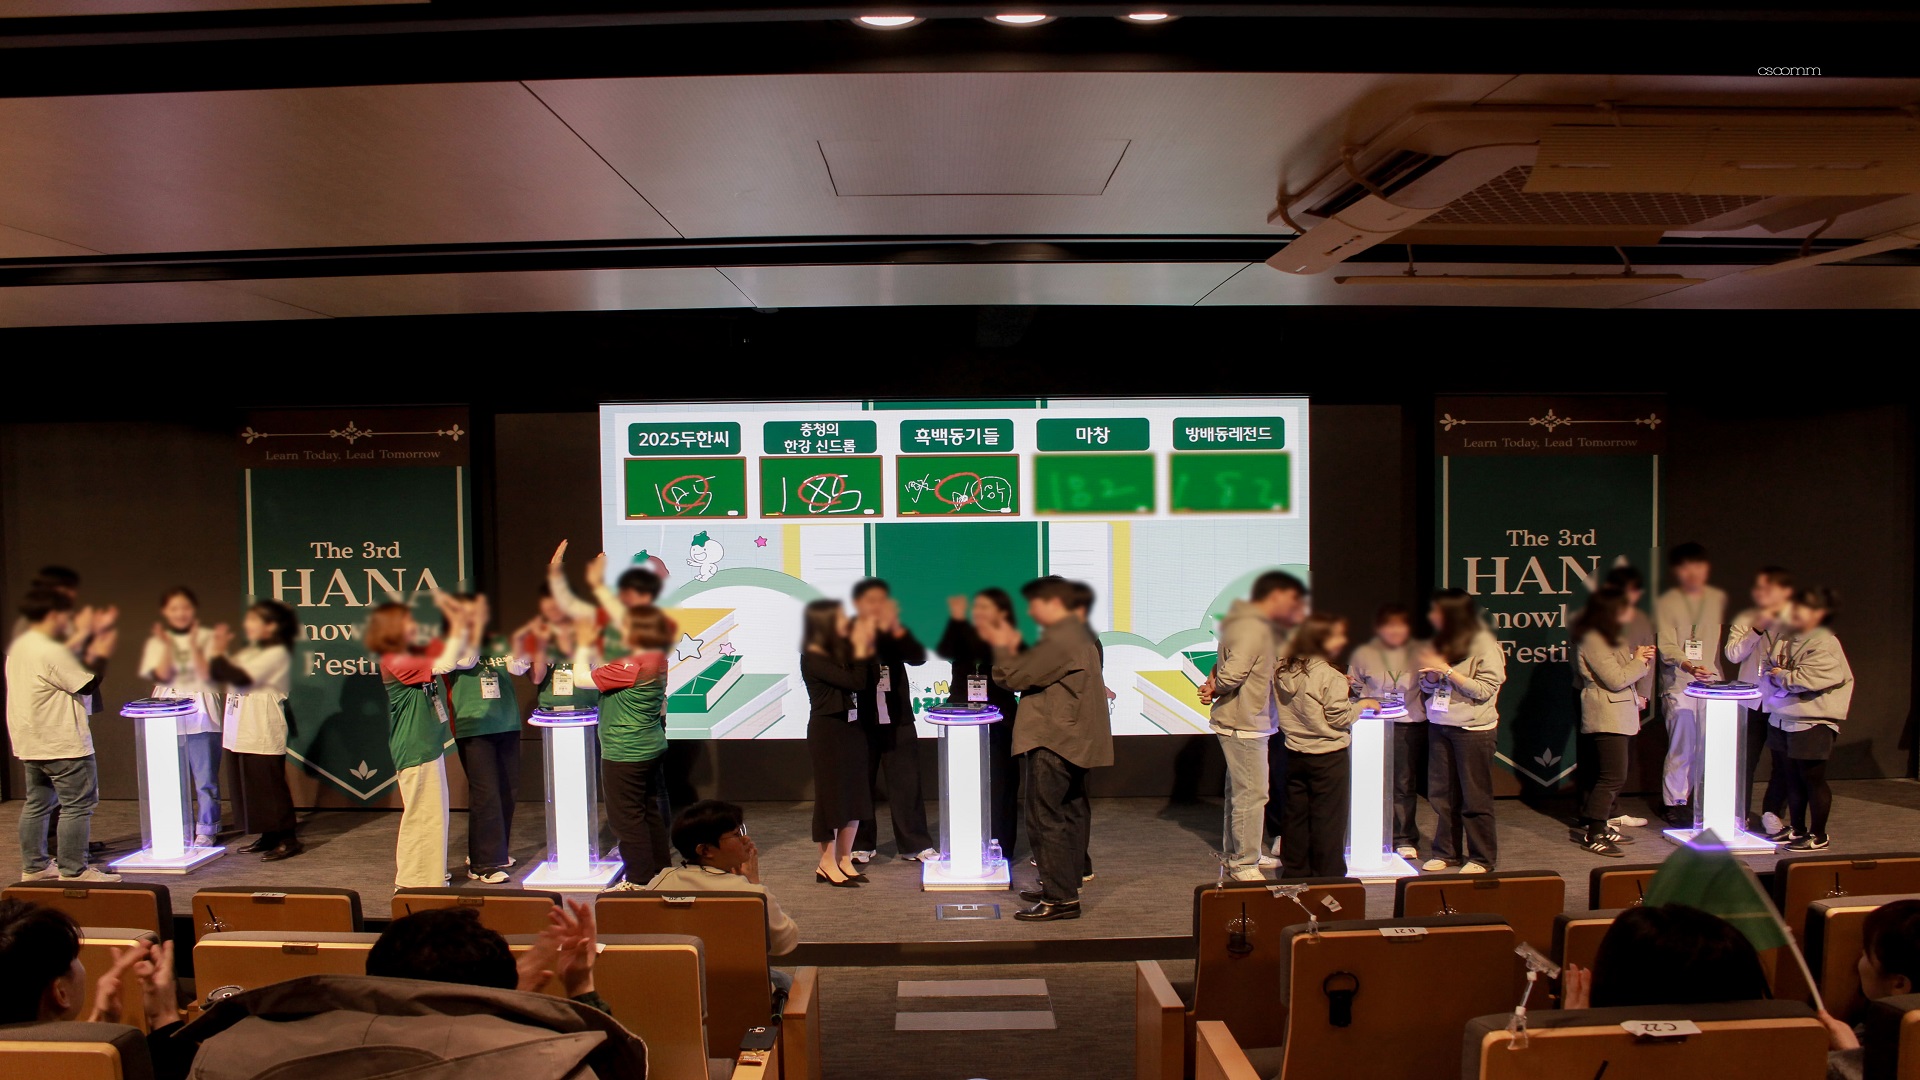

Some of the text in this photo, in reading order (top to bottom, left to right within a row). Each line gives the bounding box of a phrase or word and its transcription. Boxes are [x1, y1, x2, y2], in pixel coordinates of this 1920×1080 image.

[799, 422, 839, 437] 충청의
[914, 427, 1000, 446] 흑백동기들
[1075, 426, 1111, 445] 마창
[1185, 426, 1273, 443] 방배동레전드
[638, 430, 730, 448] 2025두한씨
[784, 439, 857, 454] 한강 신드롬
[1463, 438, 1497, 448] Learn
[1545, 438, 1573, 448] Lead
[1578, 437, 1638, 447] Tomorrow
[265, 451, 299, 461] Learn
[346, 450, 375, 460] Lead
[379, 450, 441, 459] Tomorrow
[1506, 529, 1597, 547] The 3rd
[310, 541, 401, 559] The 3rd
[1463, 555, 1626, 595] HAN
[1498, 640, 1570, 663] Festi
[1640, 1022, 1677, 1031] C 22
